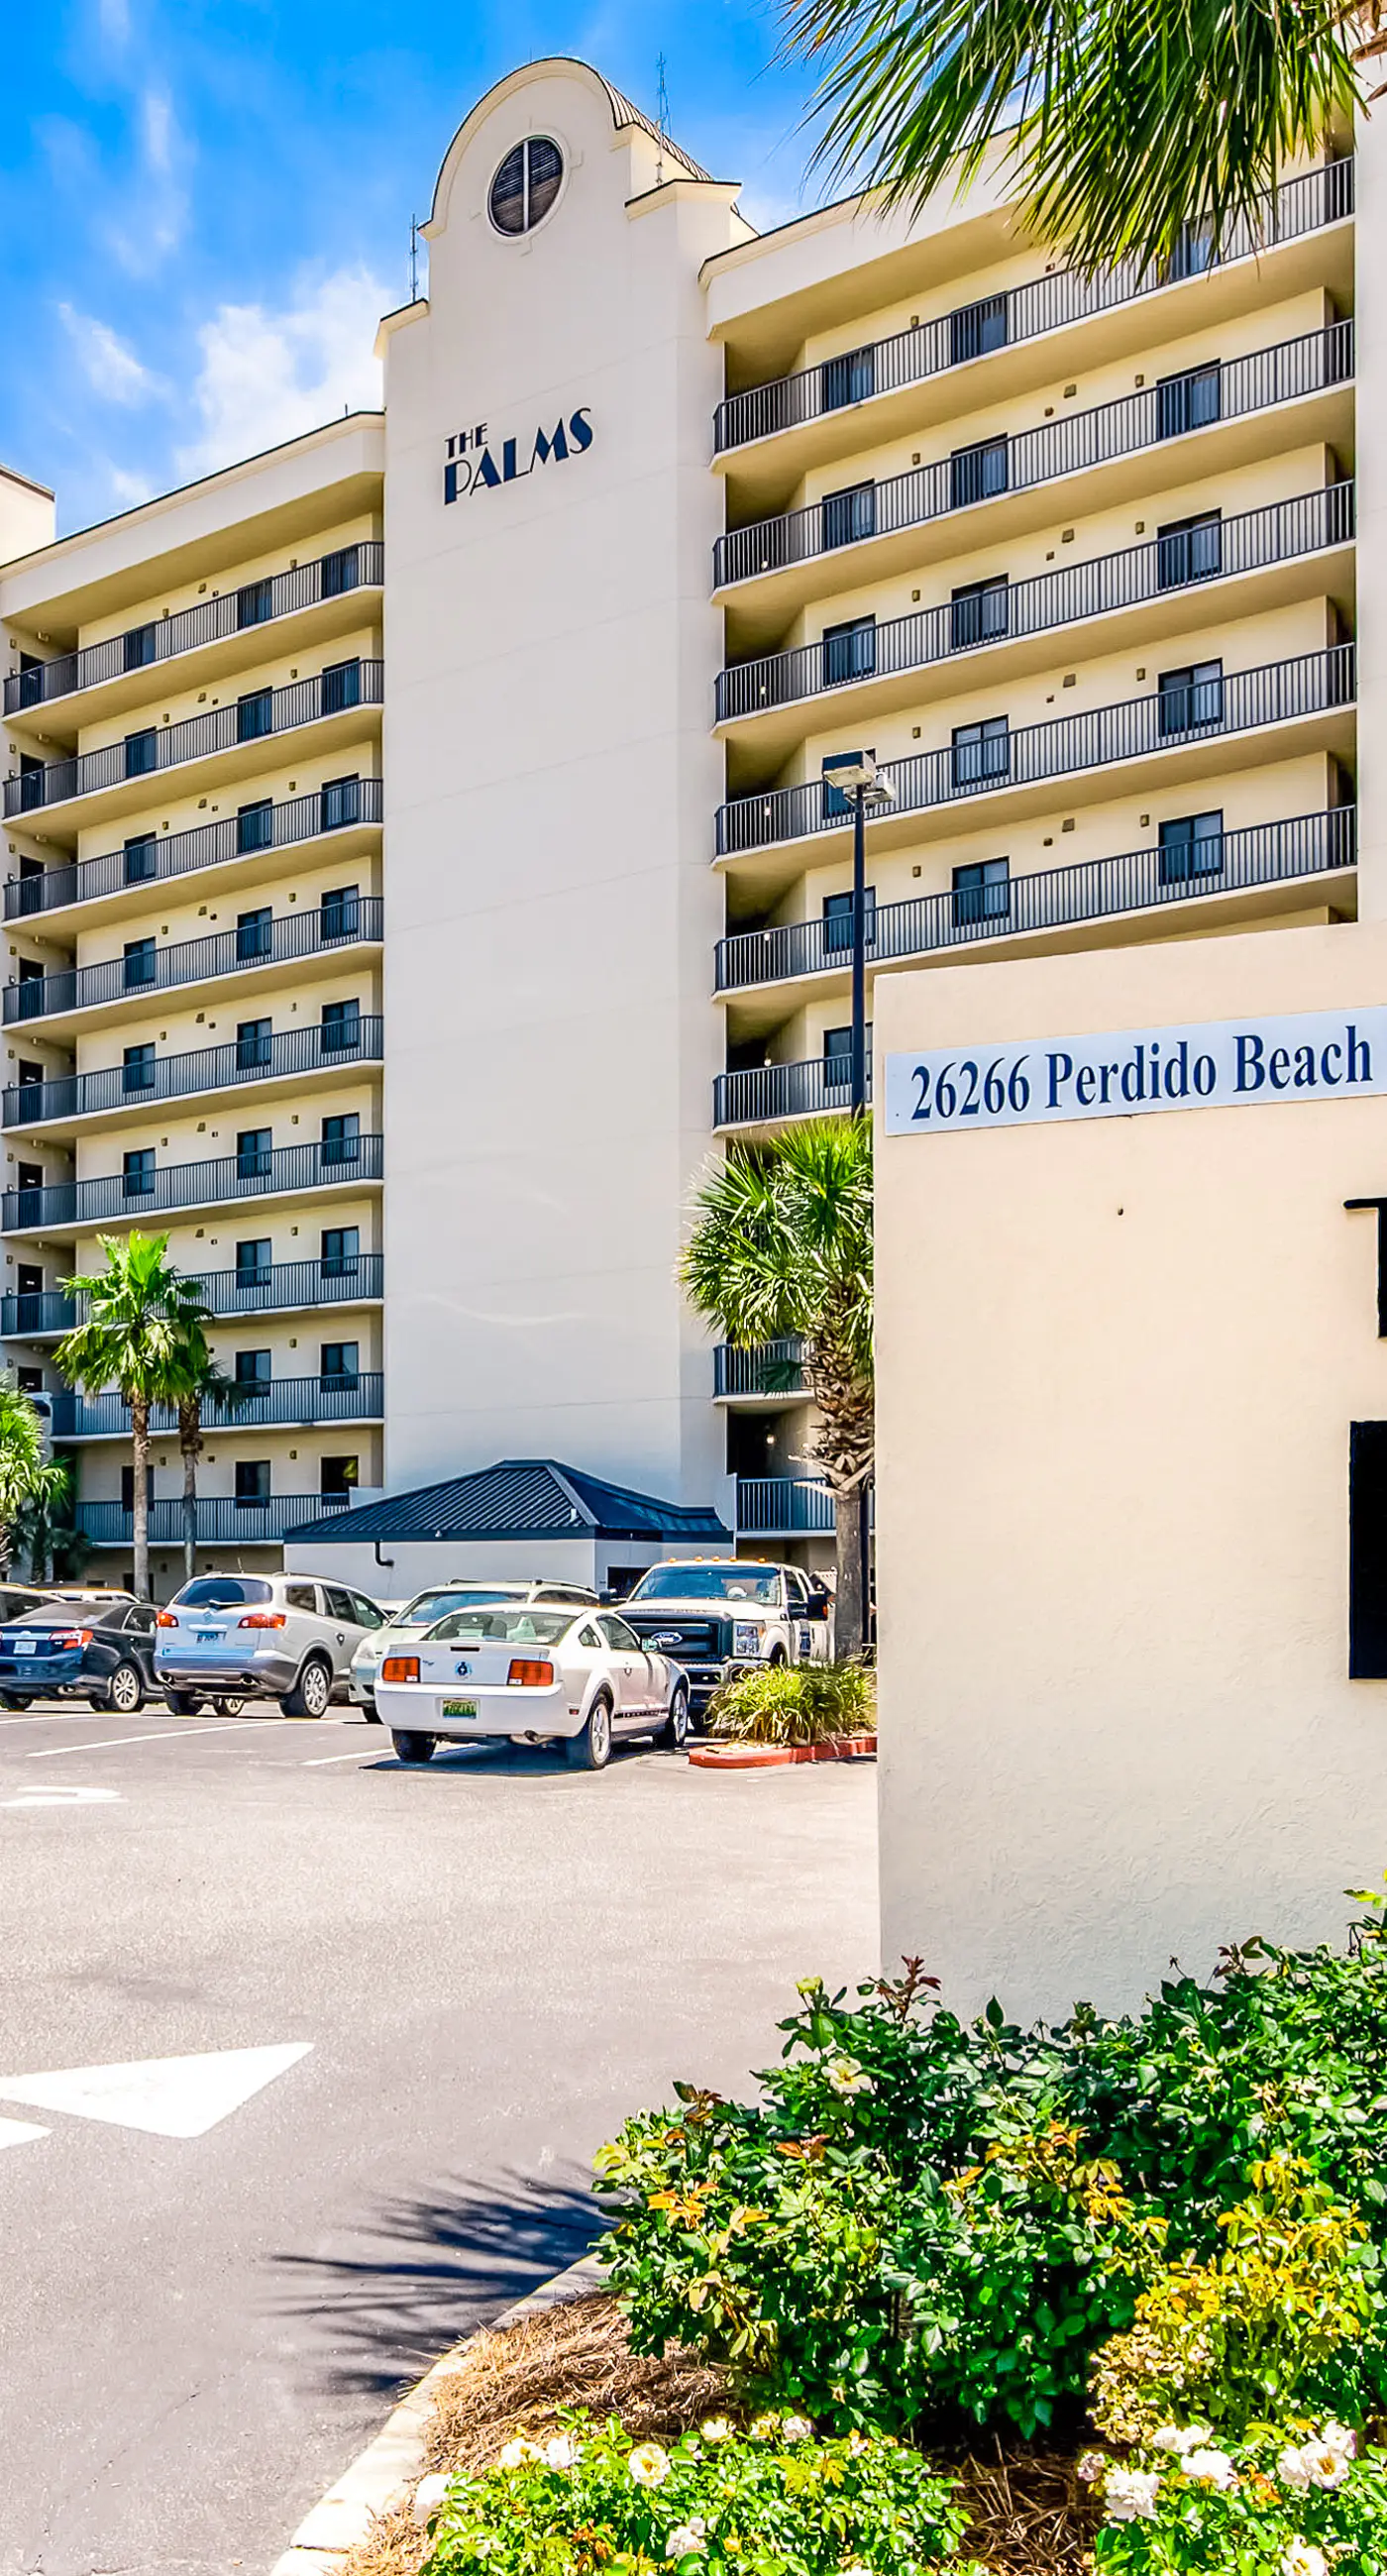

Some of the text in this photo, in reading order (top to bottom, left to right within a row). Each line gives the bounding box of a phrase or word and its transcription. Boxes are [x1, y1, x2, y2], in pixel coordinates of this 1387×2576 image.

[444, 422, 488, 459] THE
[444, 407, 593, 505] PALMS
[910, 1024, 1373, 1121] 26266 Perdido Beach
